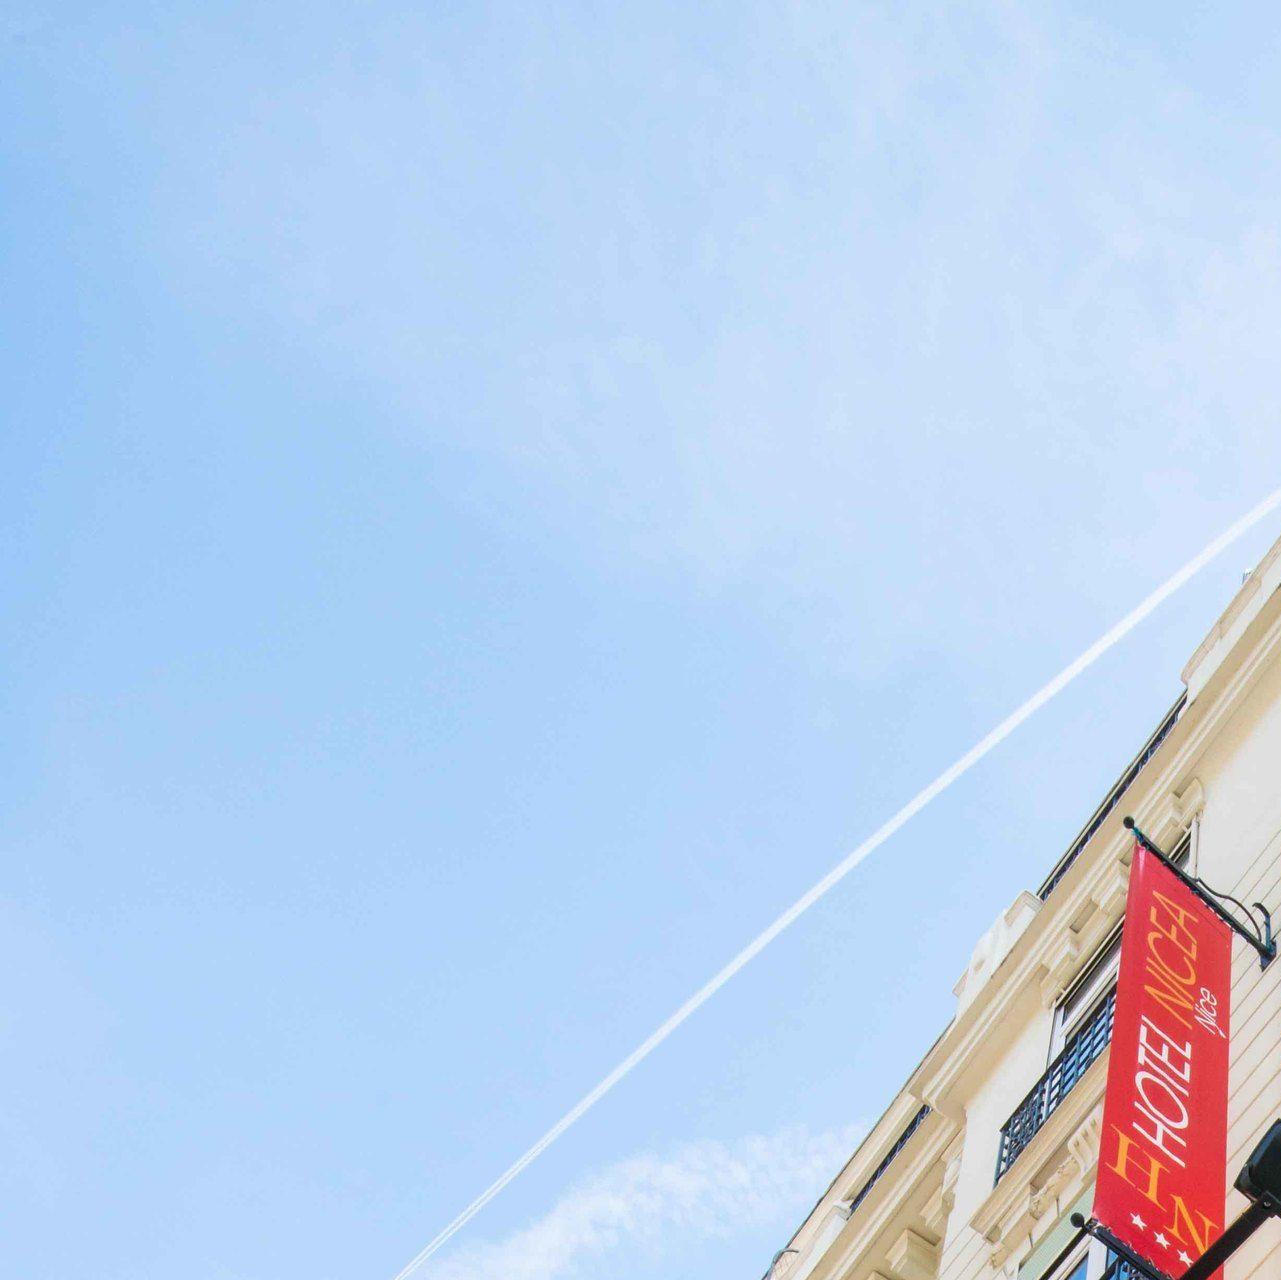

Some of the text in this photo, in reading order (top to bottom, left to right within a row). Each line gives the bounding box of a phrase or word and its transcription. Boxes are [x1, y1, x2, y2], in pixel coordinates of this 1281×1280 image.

[1132, 889, 1199, 1169] HOTEL NICEA
[1193, 986, 1227, 1039] Nice
